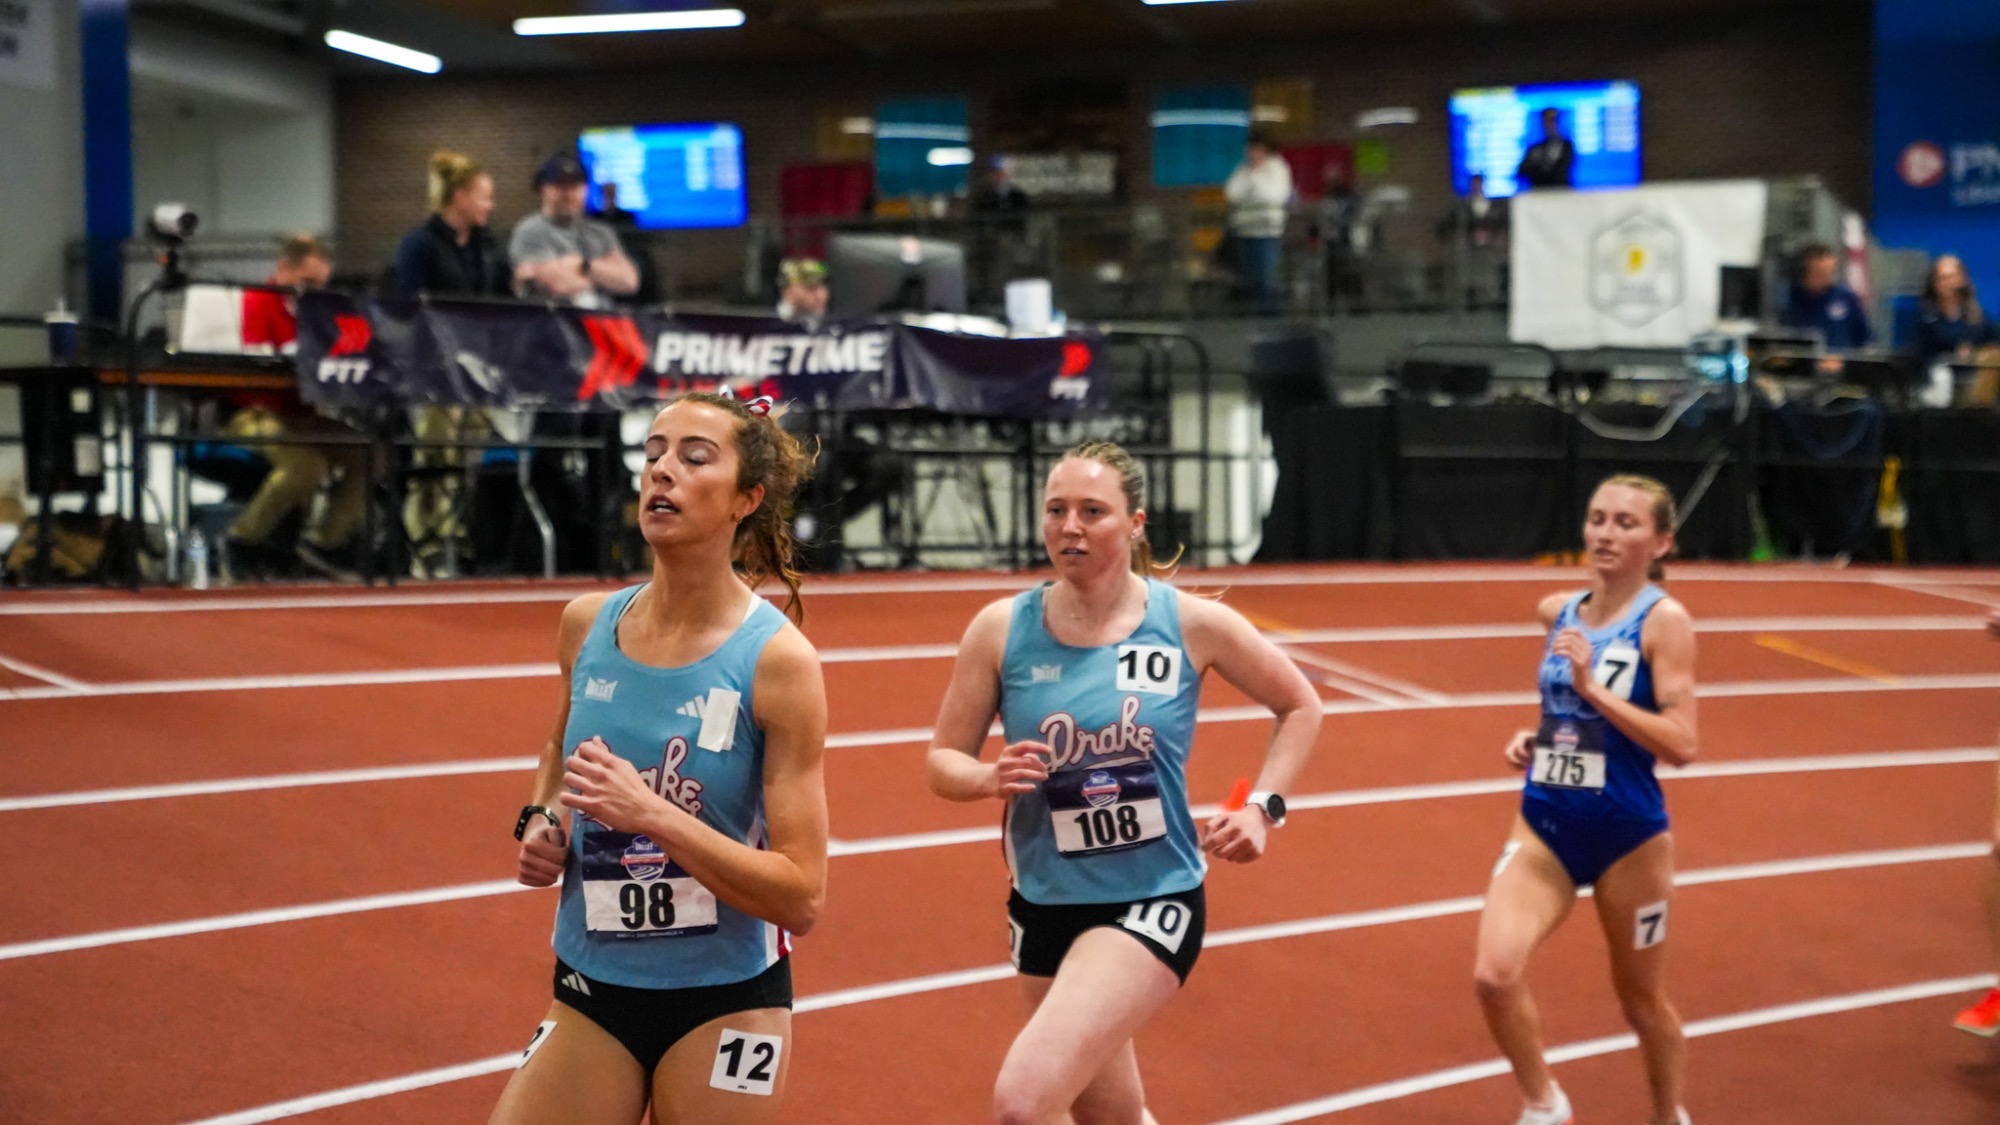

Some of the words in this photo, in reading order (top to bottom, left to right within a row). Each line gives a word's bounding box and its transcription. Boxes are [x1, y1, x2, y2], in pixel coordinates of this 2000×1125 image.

[653, 331, 890, 377] PRIMETIME
[1118, 650, 1171, 683] 10
[1605, 659, 1630, 688] 7
[1038, 694, 1155, 773] Drake
[1546, 753, 1586, 785] 275
[1074, 805, 1141, 848] 108
[619, 882, 675, 930] 98
[1137, 902, 1182, 936] 10
[1640, 913, 1662, 945] 7
[719, 1038, 775, 1082] 12
